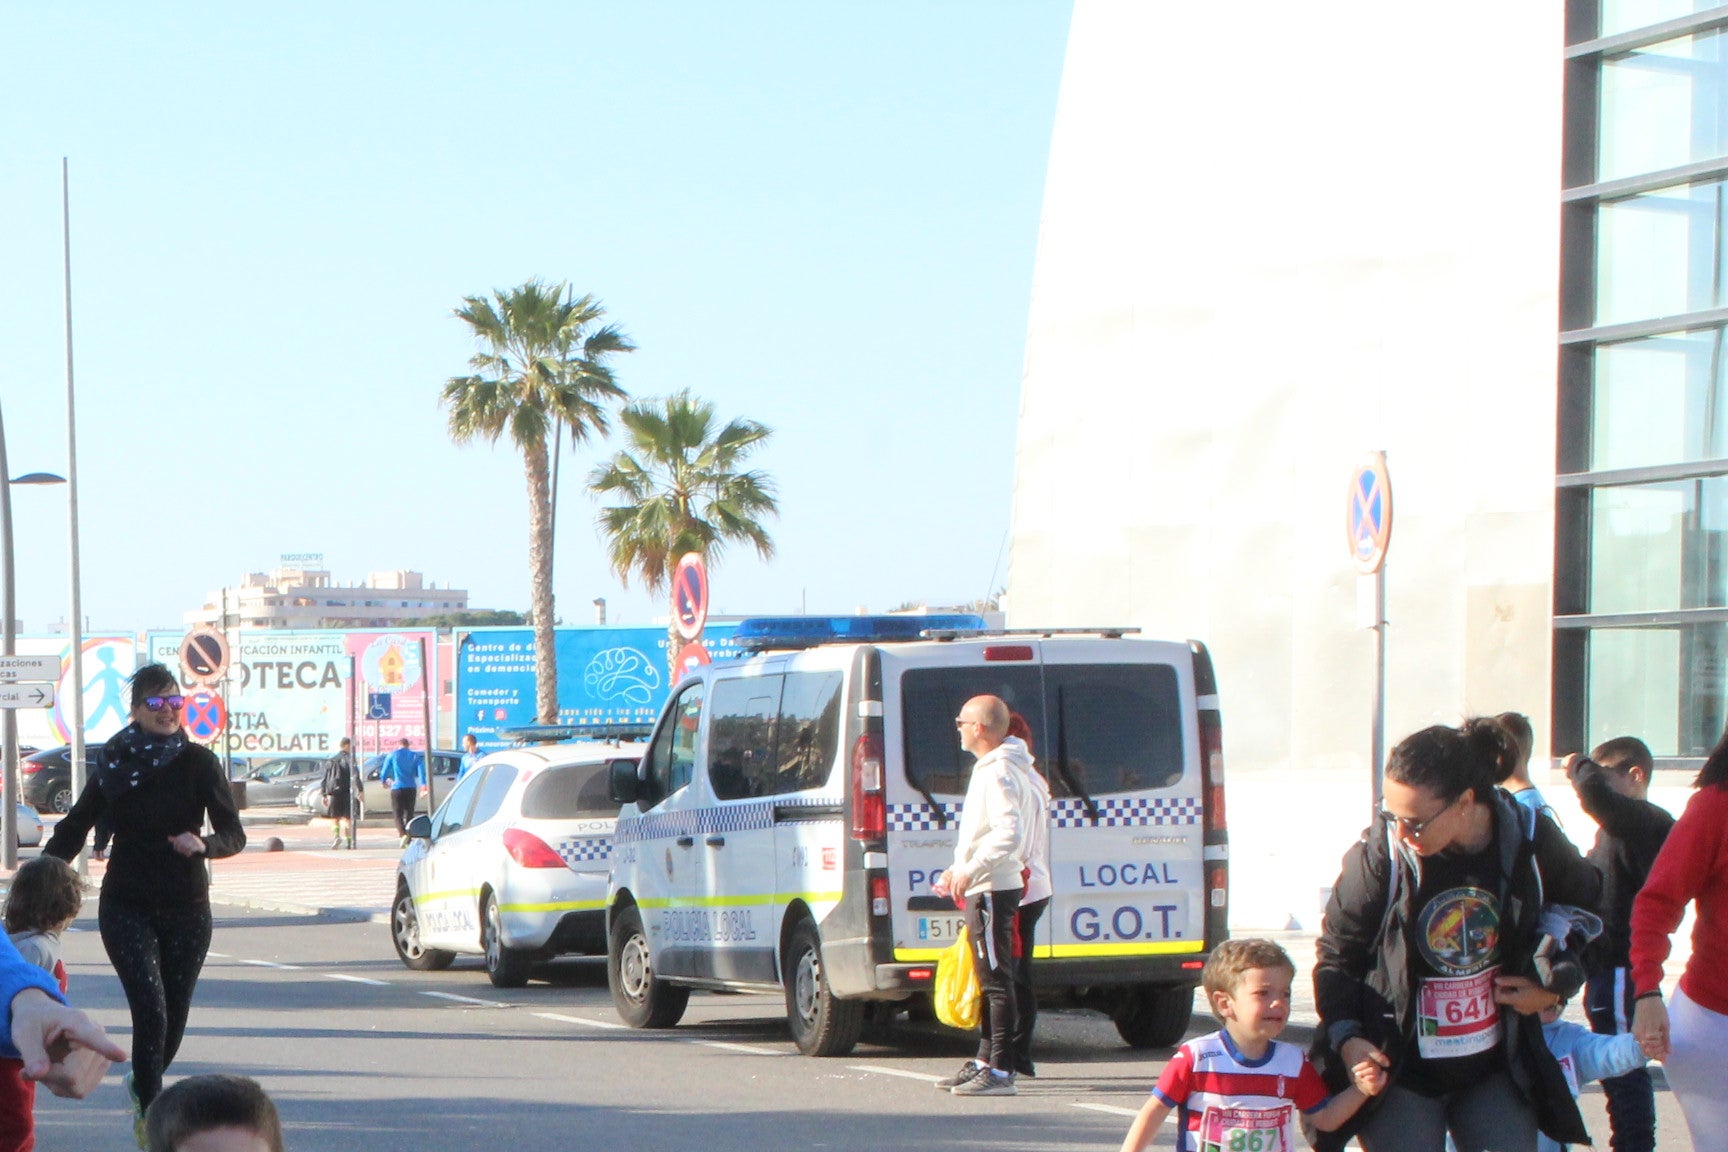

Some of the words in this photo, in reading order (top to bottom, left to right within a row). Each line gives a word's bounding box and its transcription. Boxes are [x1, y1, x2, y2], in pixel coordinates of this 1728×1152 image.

[158, 646, 180, 656] CEN
[290, 644, 342, 654] INFANTIL
[467, 643, 504, 652] Centro
[508, 643, 521, 651] de
[467, 688, 509, 696] Comedor
[512, 689, 518, 697] y
[467, 697, 519, 706] Transporte
[1079, 862, 1178, 887] LOCAL
[714, 910, 756, 940] LOCAL
[1070, 905, 1182, 941] G.O.T.
[1445, 992, 1490, 1024] 647
[1229, 1128, 1278, 1152] 867
